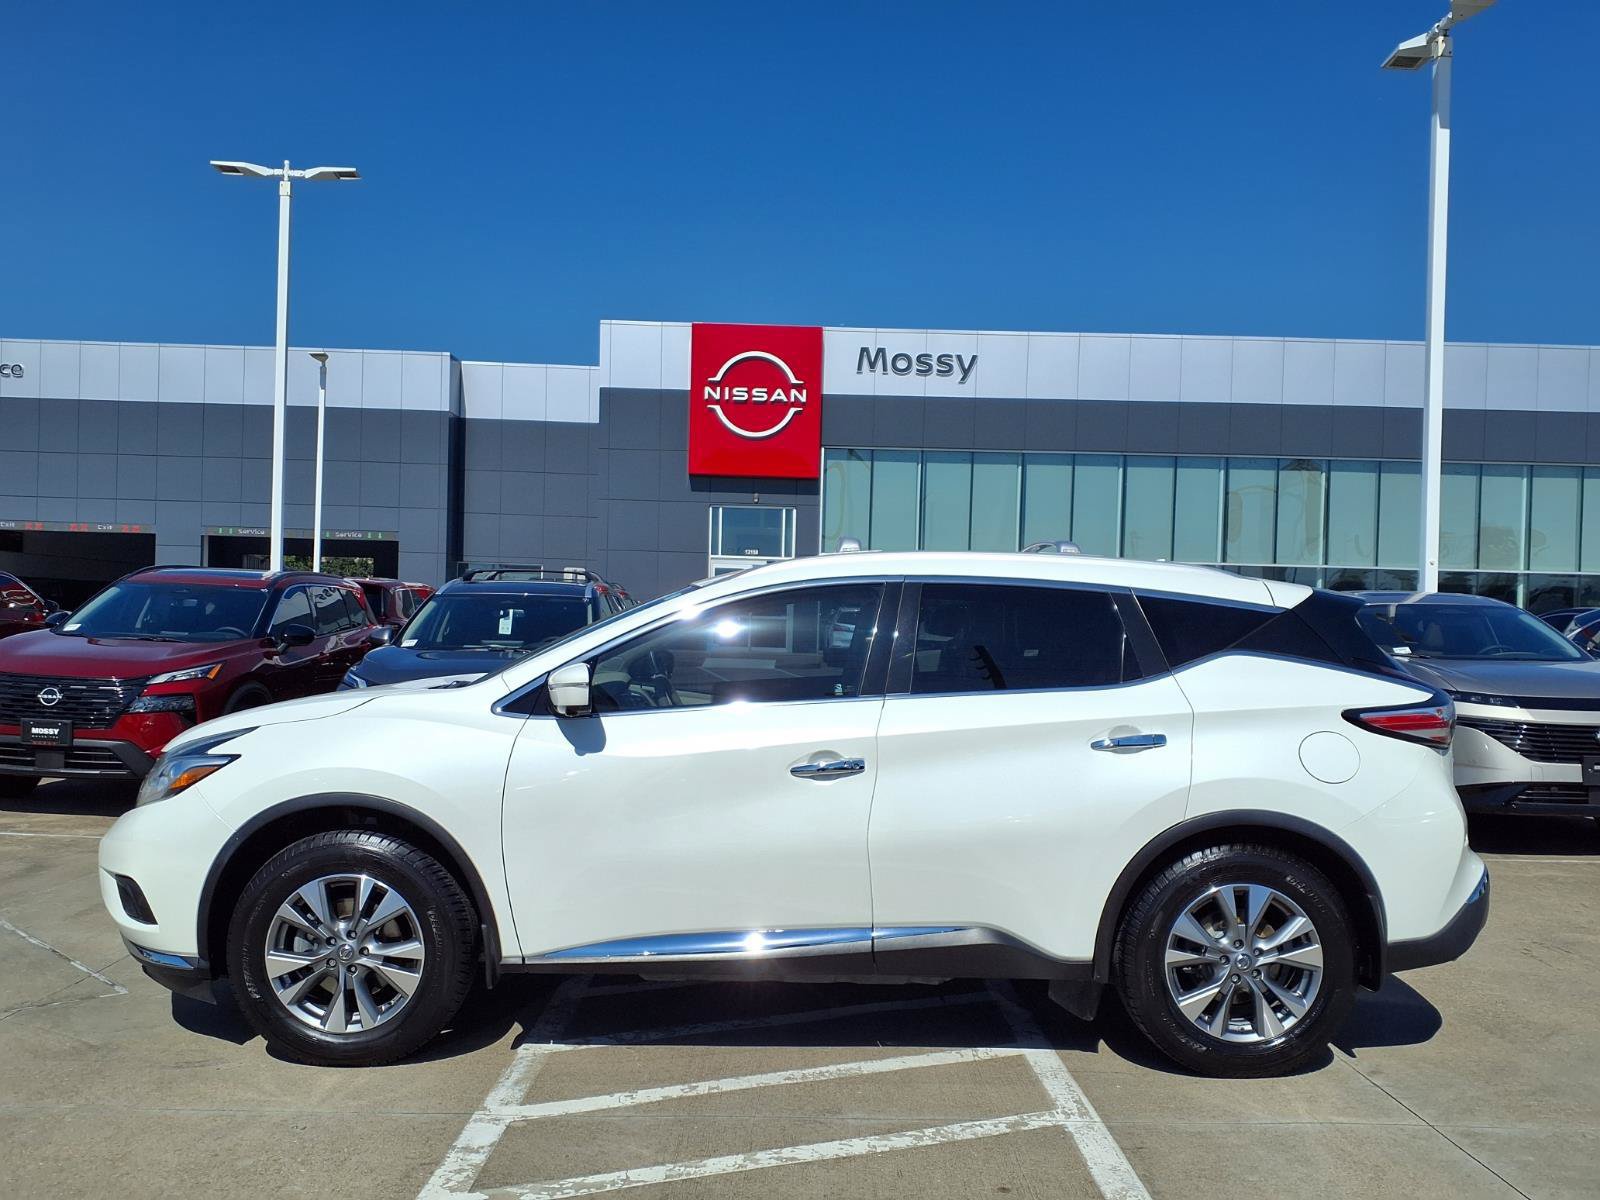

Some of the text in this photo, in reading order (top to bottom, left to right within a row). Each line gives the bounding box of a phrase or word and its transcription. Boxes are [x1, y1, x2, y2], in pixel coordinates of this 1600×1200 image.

[856, 346, 978, 384] Mossy
[703, 386, 807, 403] NISSAN
[31, 727, 60, 735] MOSSY
